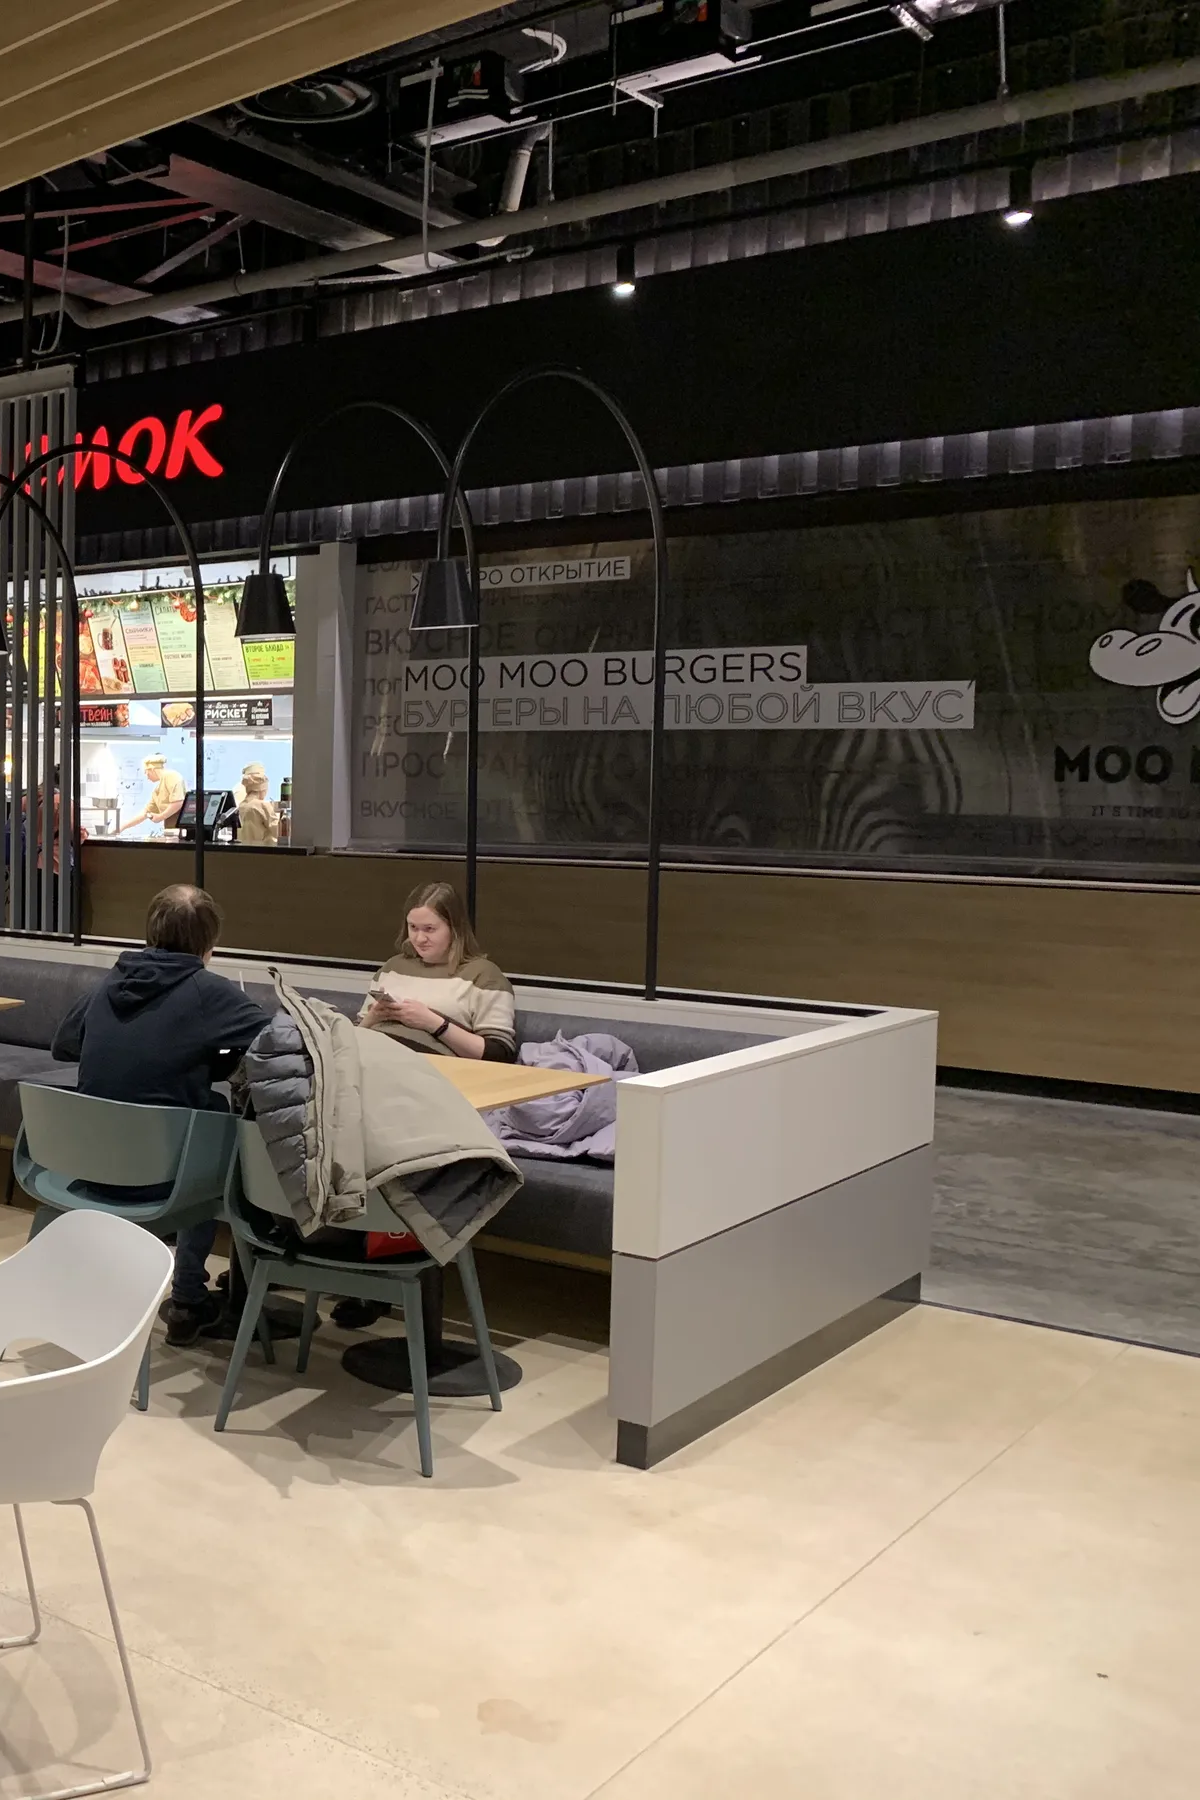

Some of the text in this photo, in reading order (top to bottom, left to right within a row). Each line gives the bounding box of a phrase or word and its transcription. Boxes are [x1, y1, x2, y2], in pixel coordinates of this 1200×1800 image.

[511, 559, 626, 584] ОТКРЫТИЕ
[405, 652, 802, 692] MOO MOO BURGERS
[203, 708, 247, 719] РИСКЕТ
[583, 695, 640, 724] НА
[650, 685, 820, 725] ЛЮБОЙ
[837, 690, 965, 723] ВКУС
[1054, 744, 1174, 784] MOO
[360, 801, 457, 819] ВКУСНОЕ
